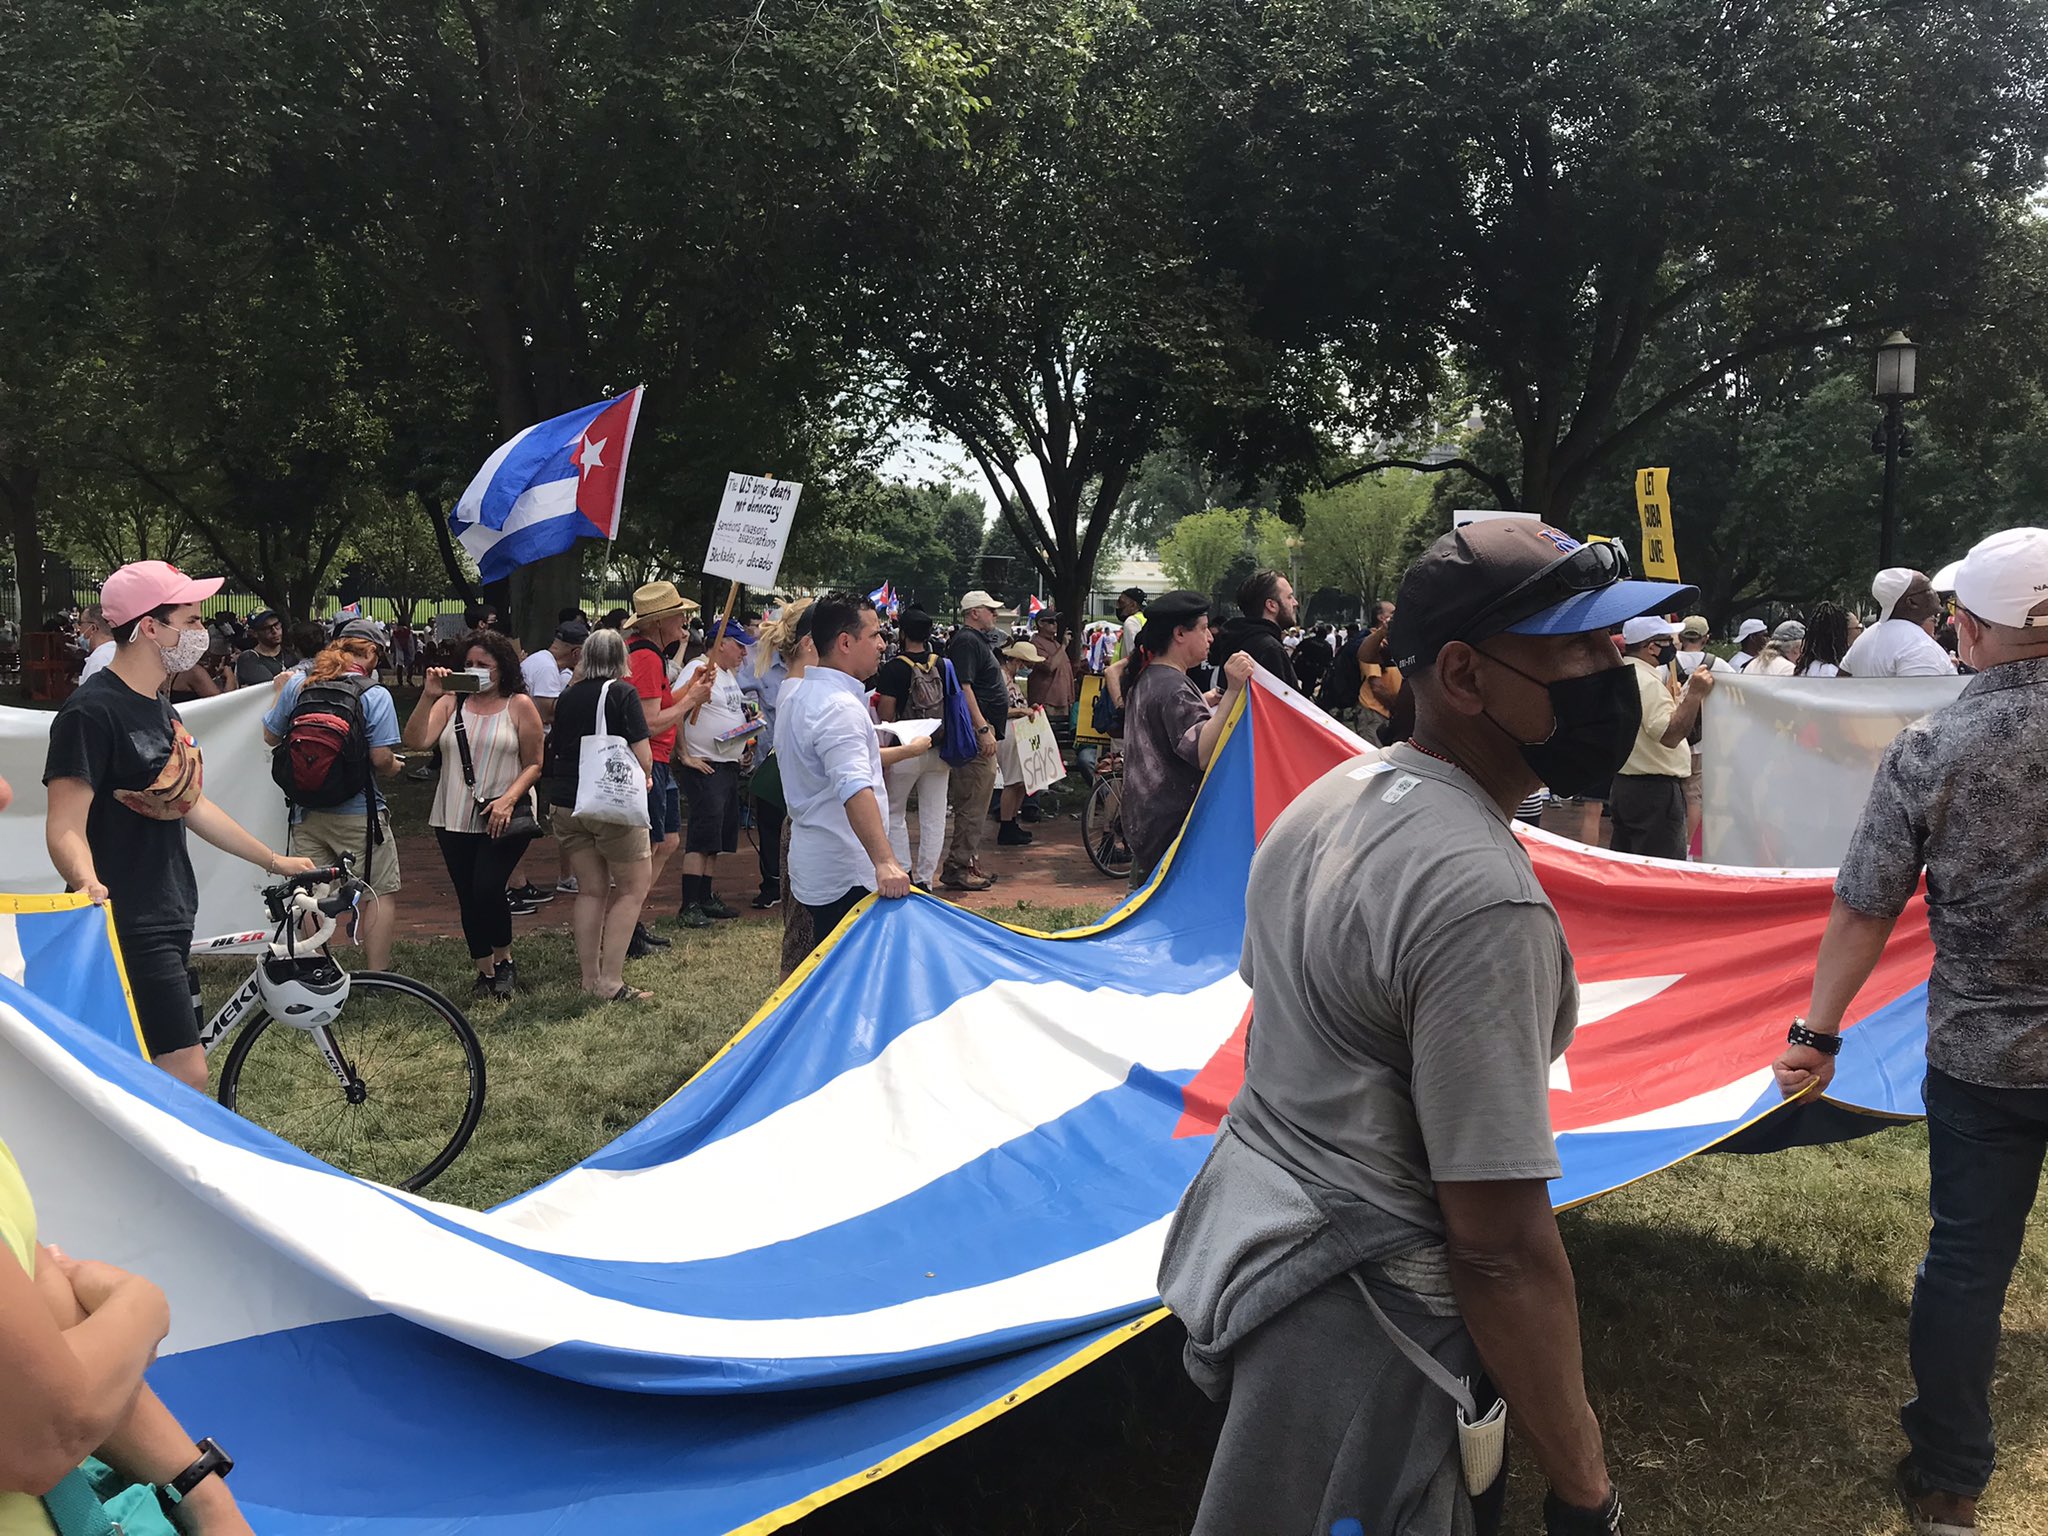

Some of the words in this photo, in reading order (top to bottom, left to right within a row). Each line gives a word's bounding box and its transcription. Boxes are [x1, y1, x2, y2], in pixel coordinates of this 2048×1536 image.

[739, 476, 753, 494] US
[769, 479, 792, 501] death
[1644, 471, 1655, 496] LET
[734, 498, 747, 513] not
[747, 495, 782, 523] democracy
[1644, 503, 1662, 528] CUBA
[746, 550, 773, 572] decades
[1023, 746, 1057, 790] SAYS
[323, 1049, 347, 1082] MEKK
